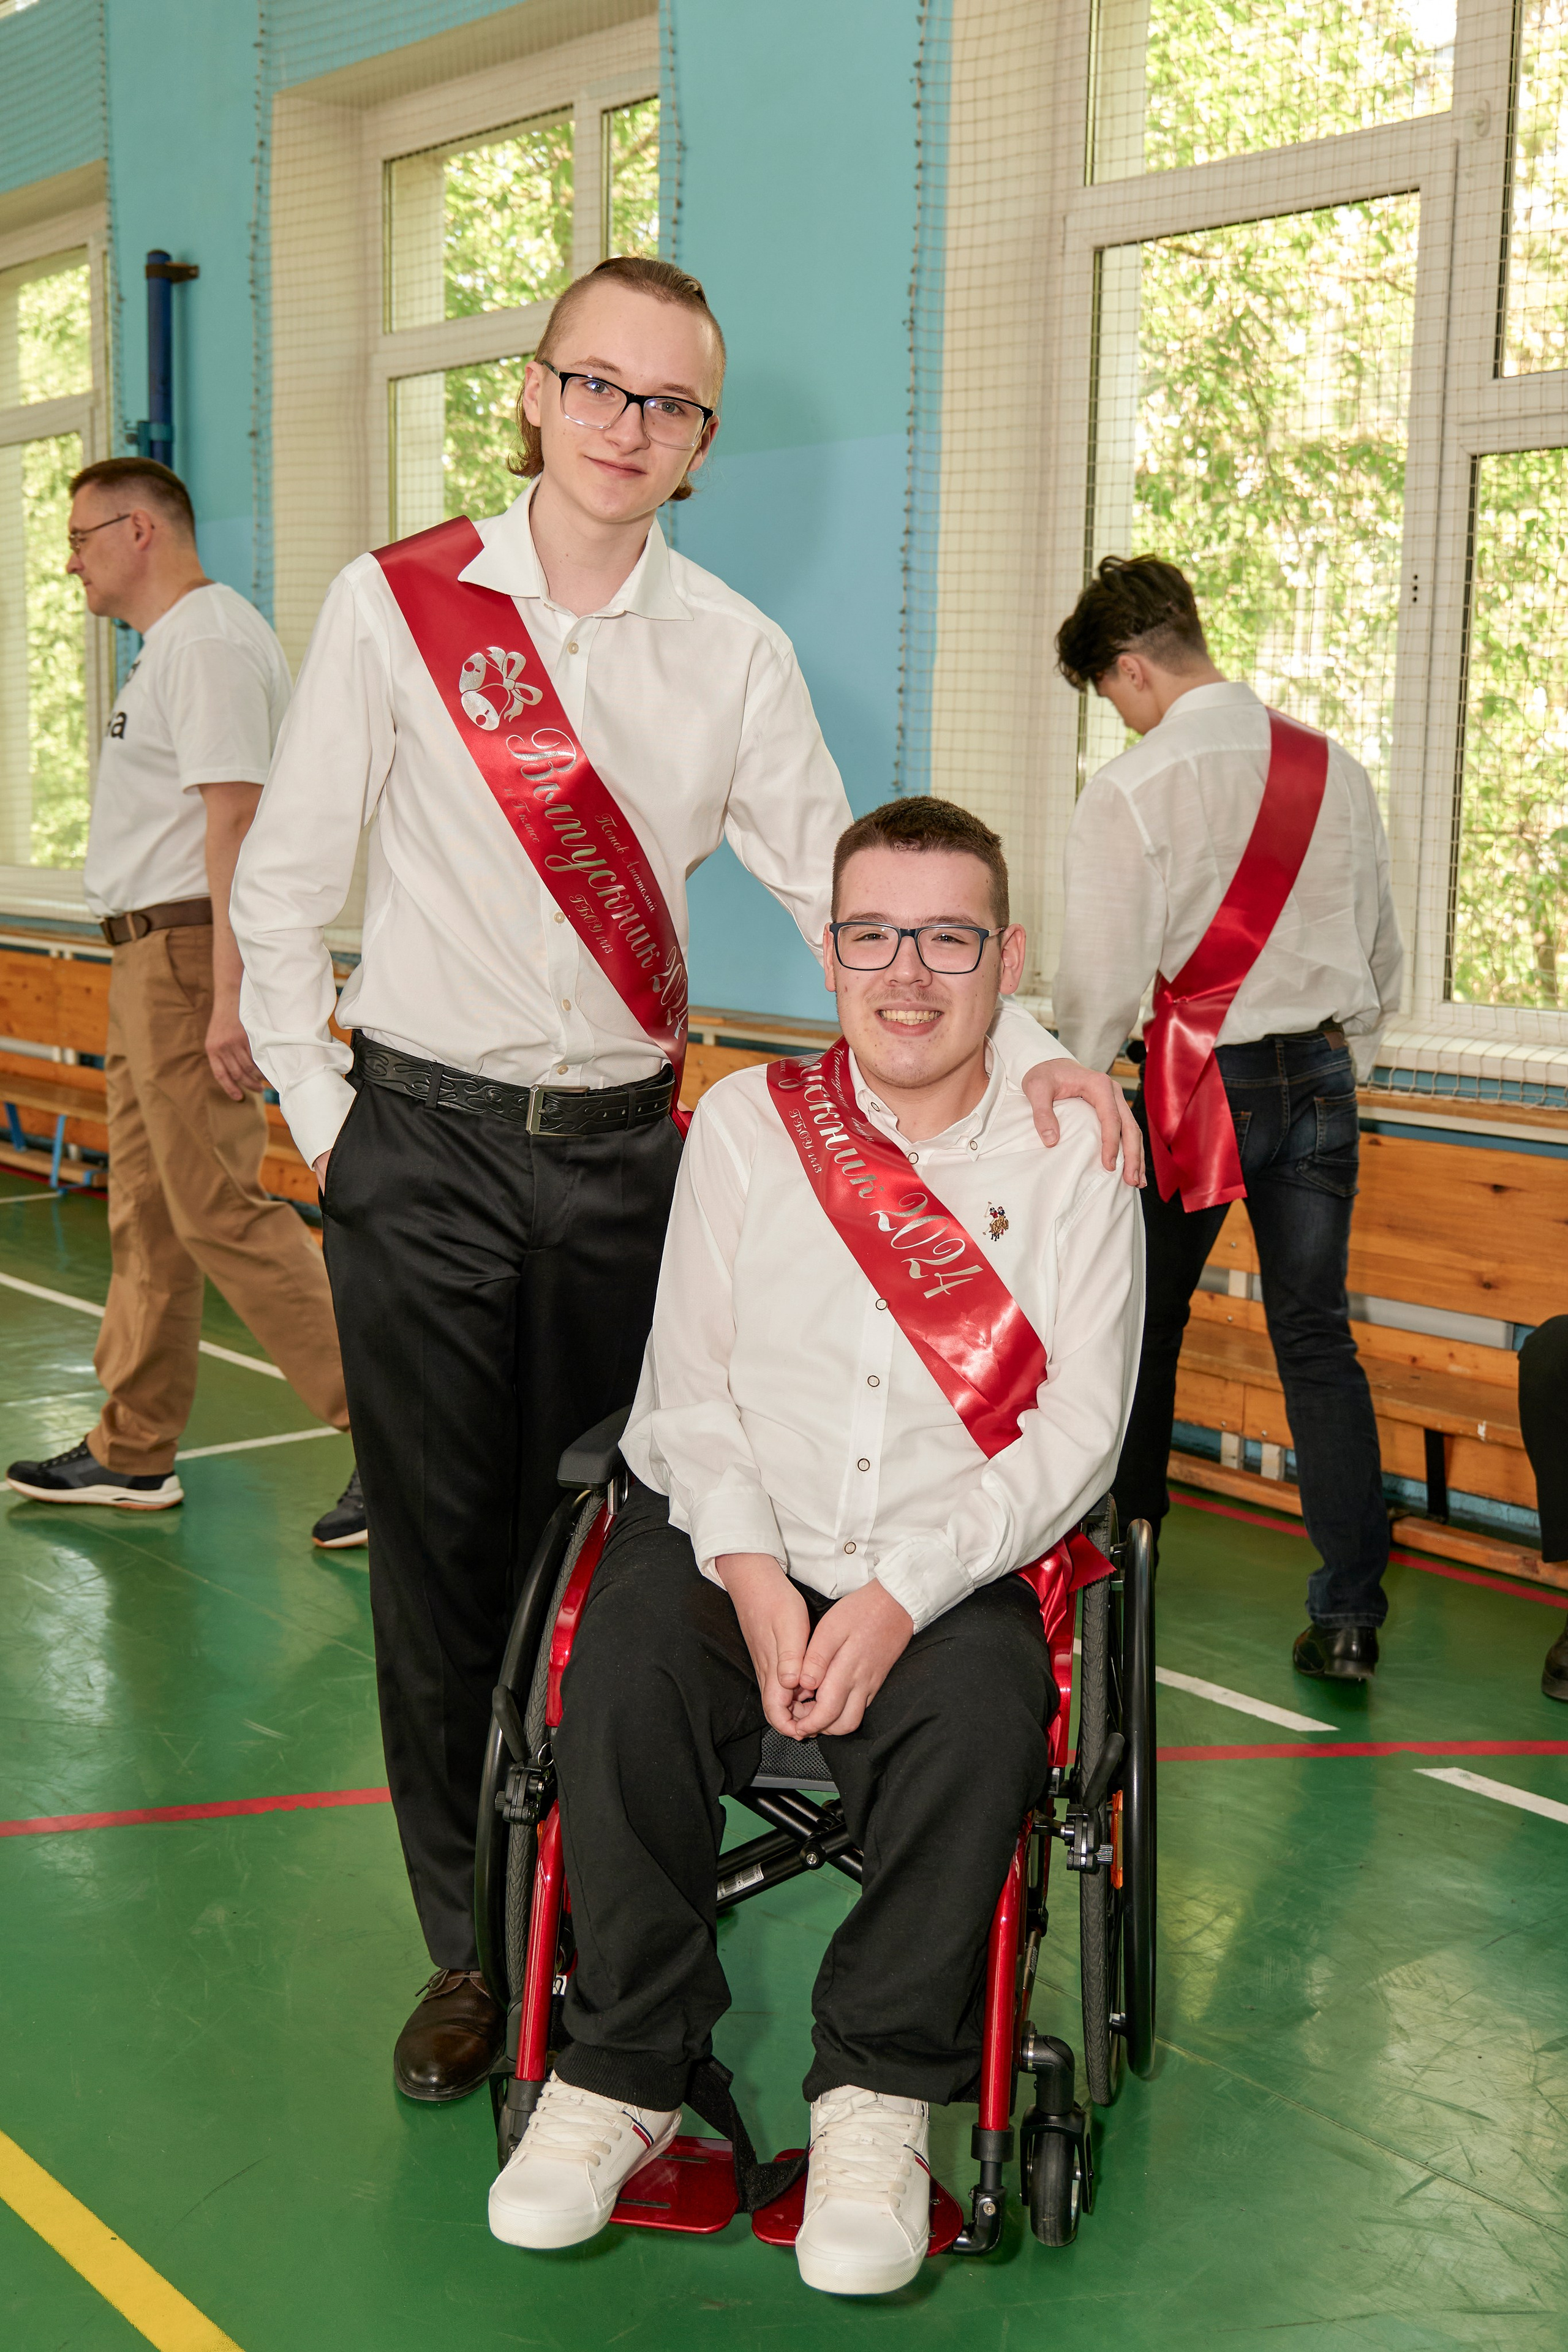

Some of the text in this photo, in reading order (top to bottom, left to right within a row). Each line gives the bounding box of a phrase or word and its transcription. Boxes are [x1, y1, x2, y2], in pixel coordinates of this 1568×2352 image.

[519, 815, 540, 843] класс
[595, 813, 659, 913] Попов Анатолий
[506, 728, 688, 1039] Выпускник 2024
[569, 894, 614, 954] ГБОУ 1413
[788, 1109, 822, 1174] ГБОУ 1413
[870, 1192, 984, 1299] 2024
